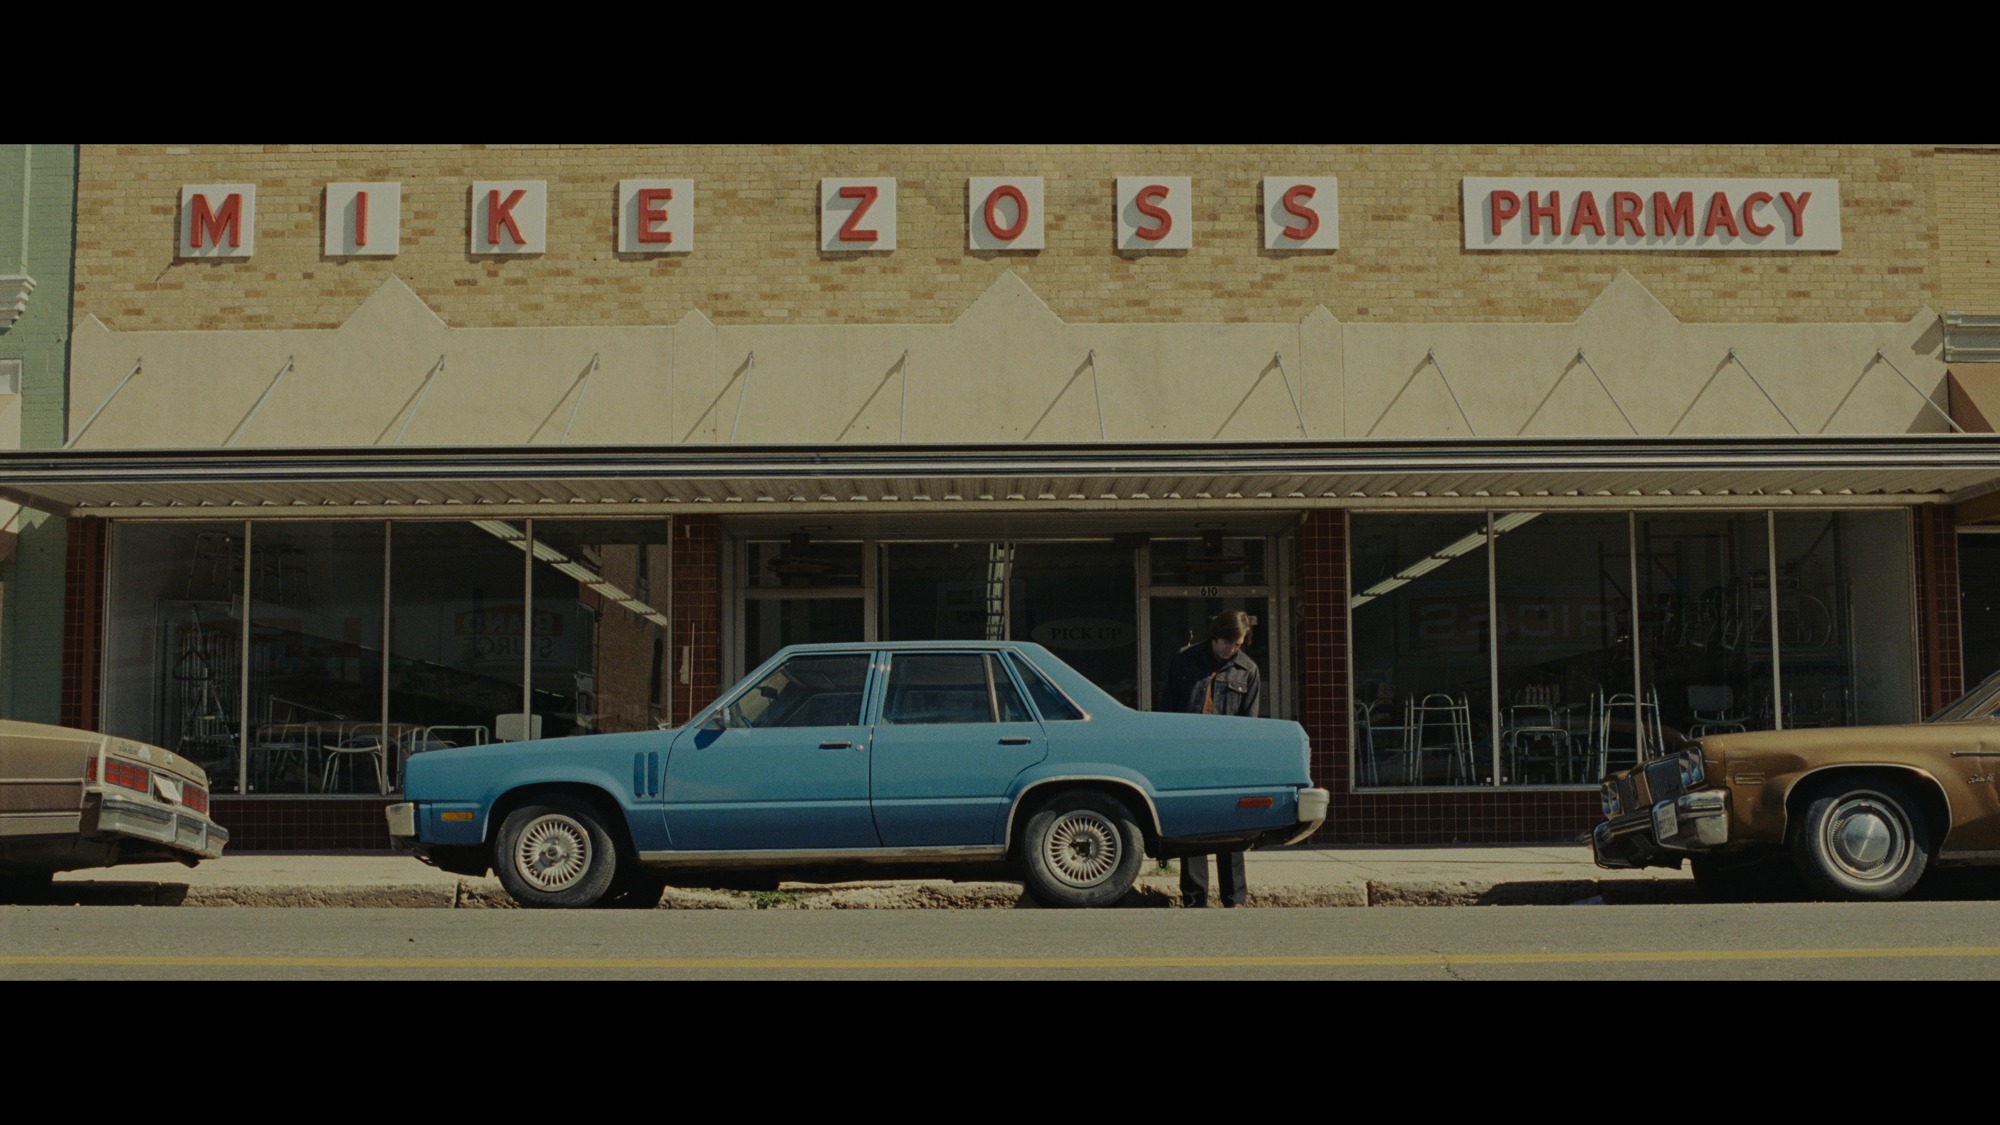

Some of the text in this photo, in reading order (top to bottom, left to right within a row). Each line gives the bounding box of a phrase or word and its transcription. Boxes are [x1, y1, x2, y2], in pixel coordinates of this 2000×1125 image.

[190, 184, 1812, 248] MIKE ZOSS PHARMACY
[1201, 585, 1218, 596] 610
[1051, 627, 1122, 640] PICK UP
